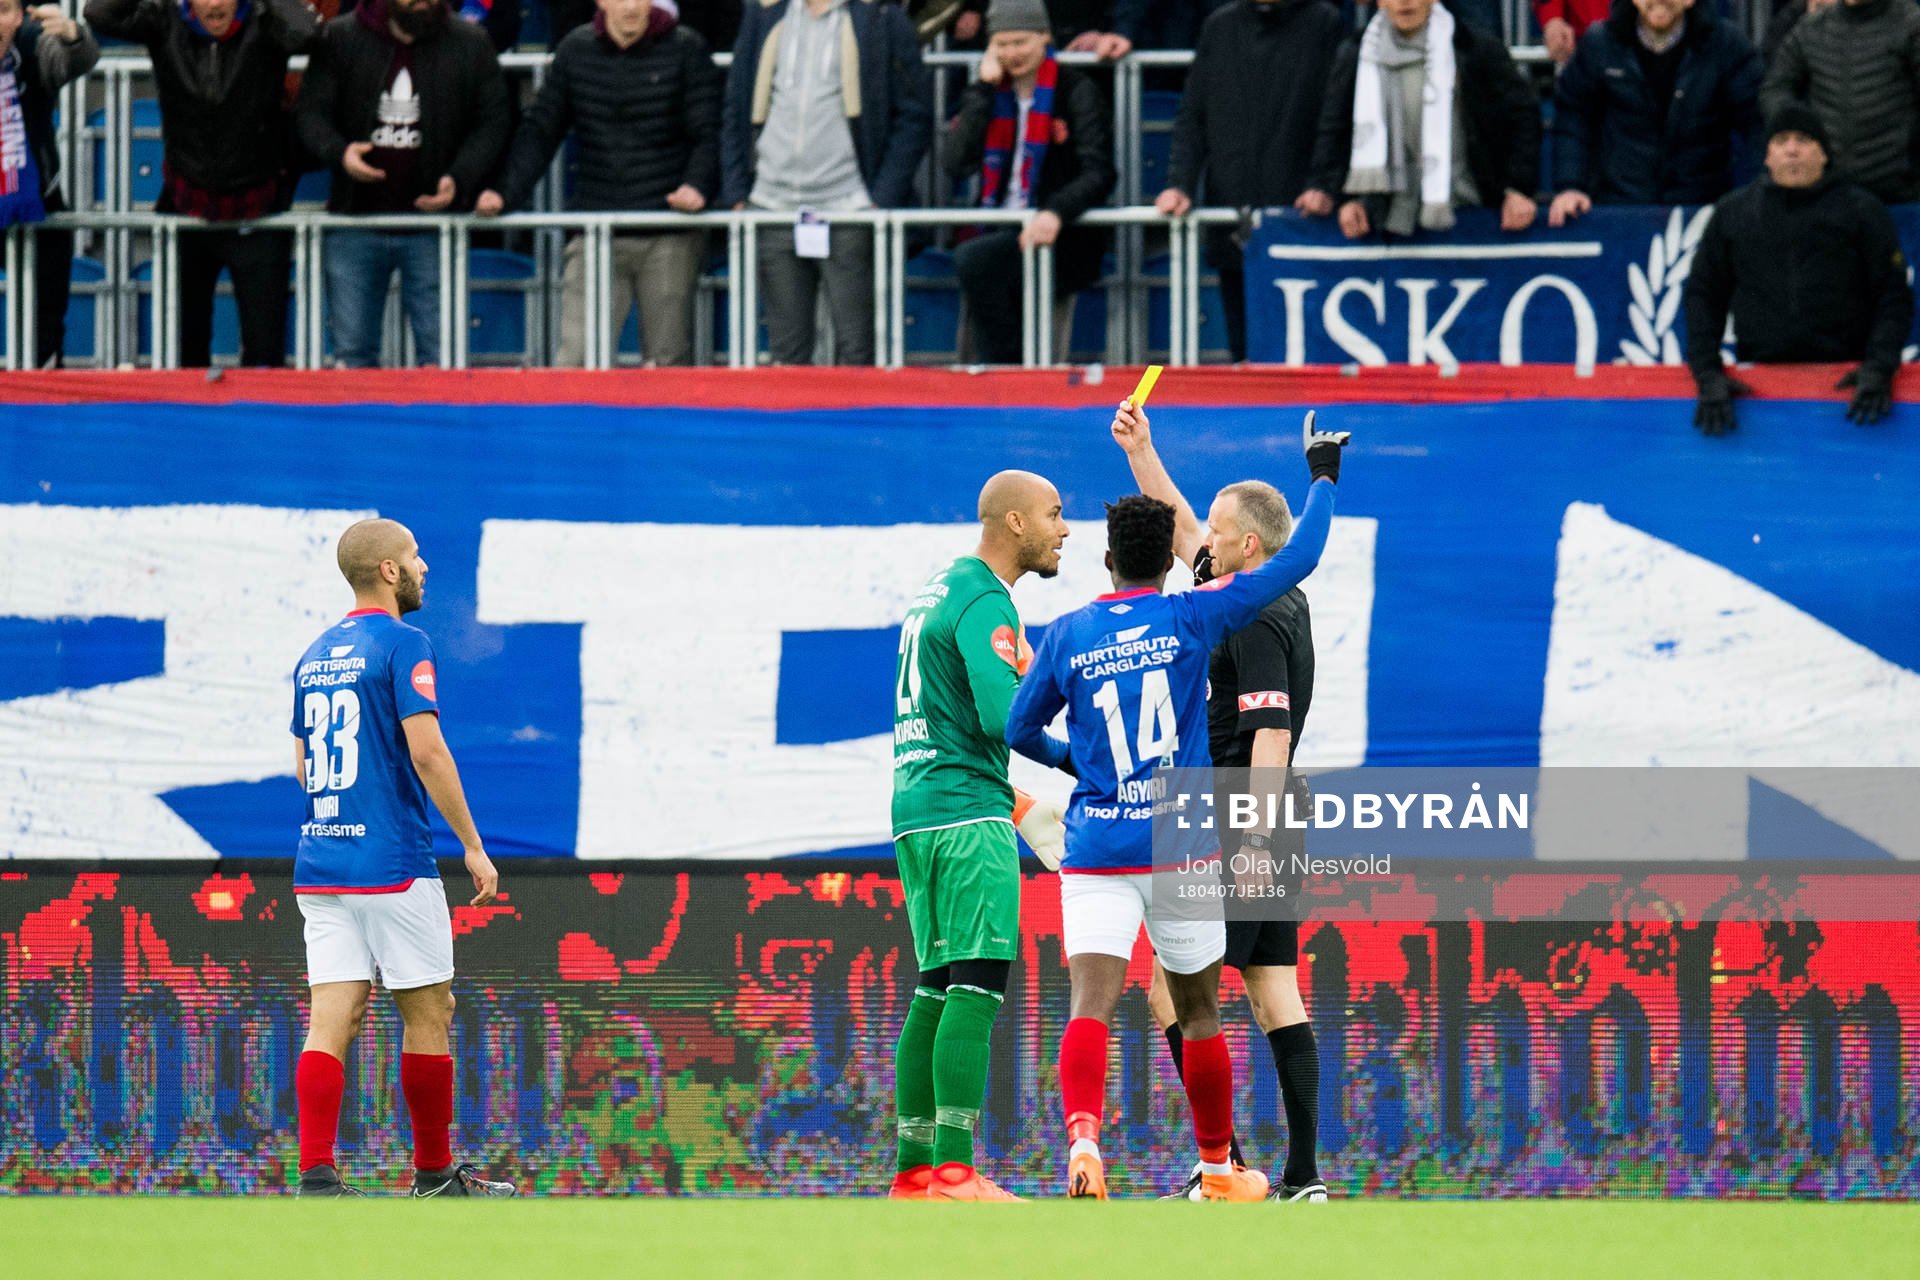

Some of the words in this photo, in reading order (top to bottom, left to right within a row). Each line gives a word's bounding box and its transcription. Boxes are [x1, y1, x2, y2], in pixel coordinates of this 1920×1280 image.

[1070, 635, 1180, 669] HURTIGRUTA
[299, 657, 366, 676] HURTGRUTA
[897, 613, 926, 717] 21
[1082, 650, 1174, 680] CARGLASS
[1240, 692, 1290, 709] VG
[1092, 668, 1180, 783] 14
[304, 689, 360, 793] 33
[1085, 806, 1120, 820] mot
[312, 823, 366, 837] rasisme
[1161, 936, 1196, 945] umbro
